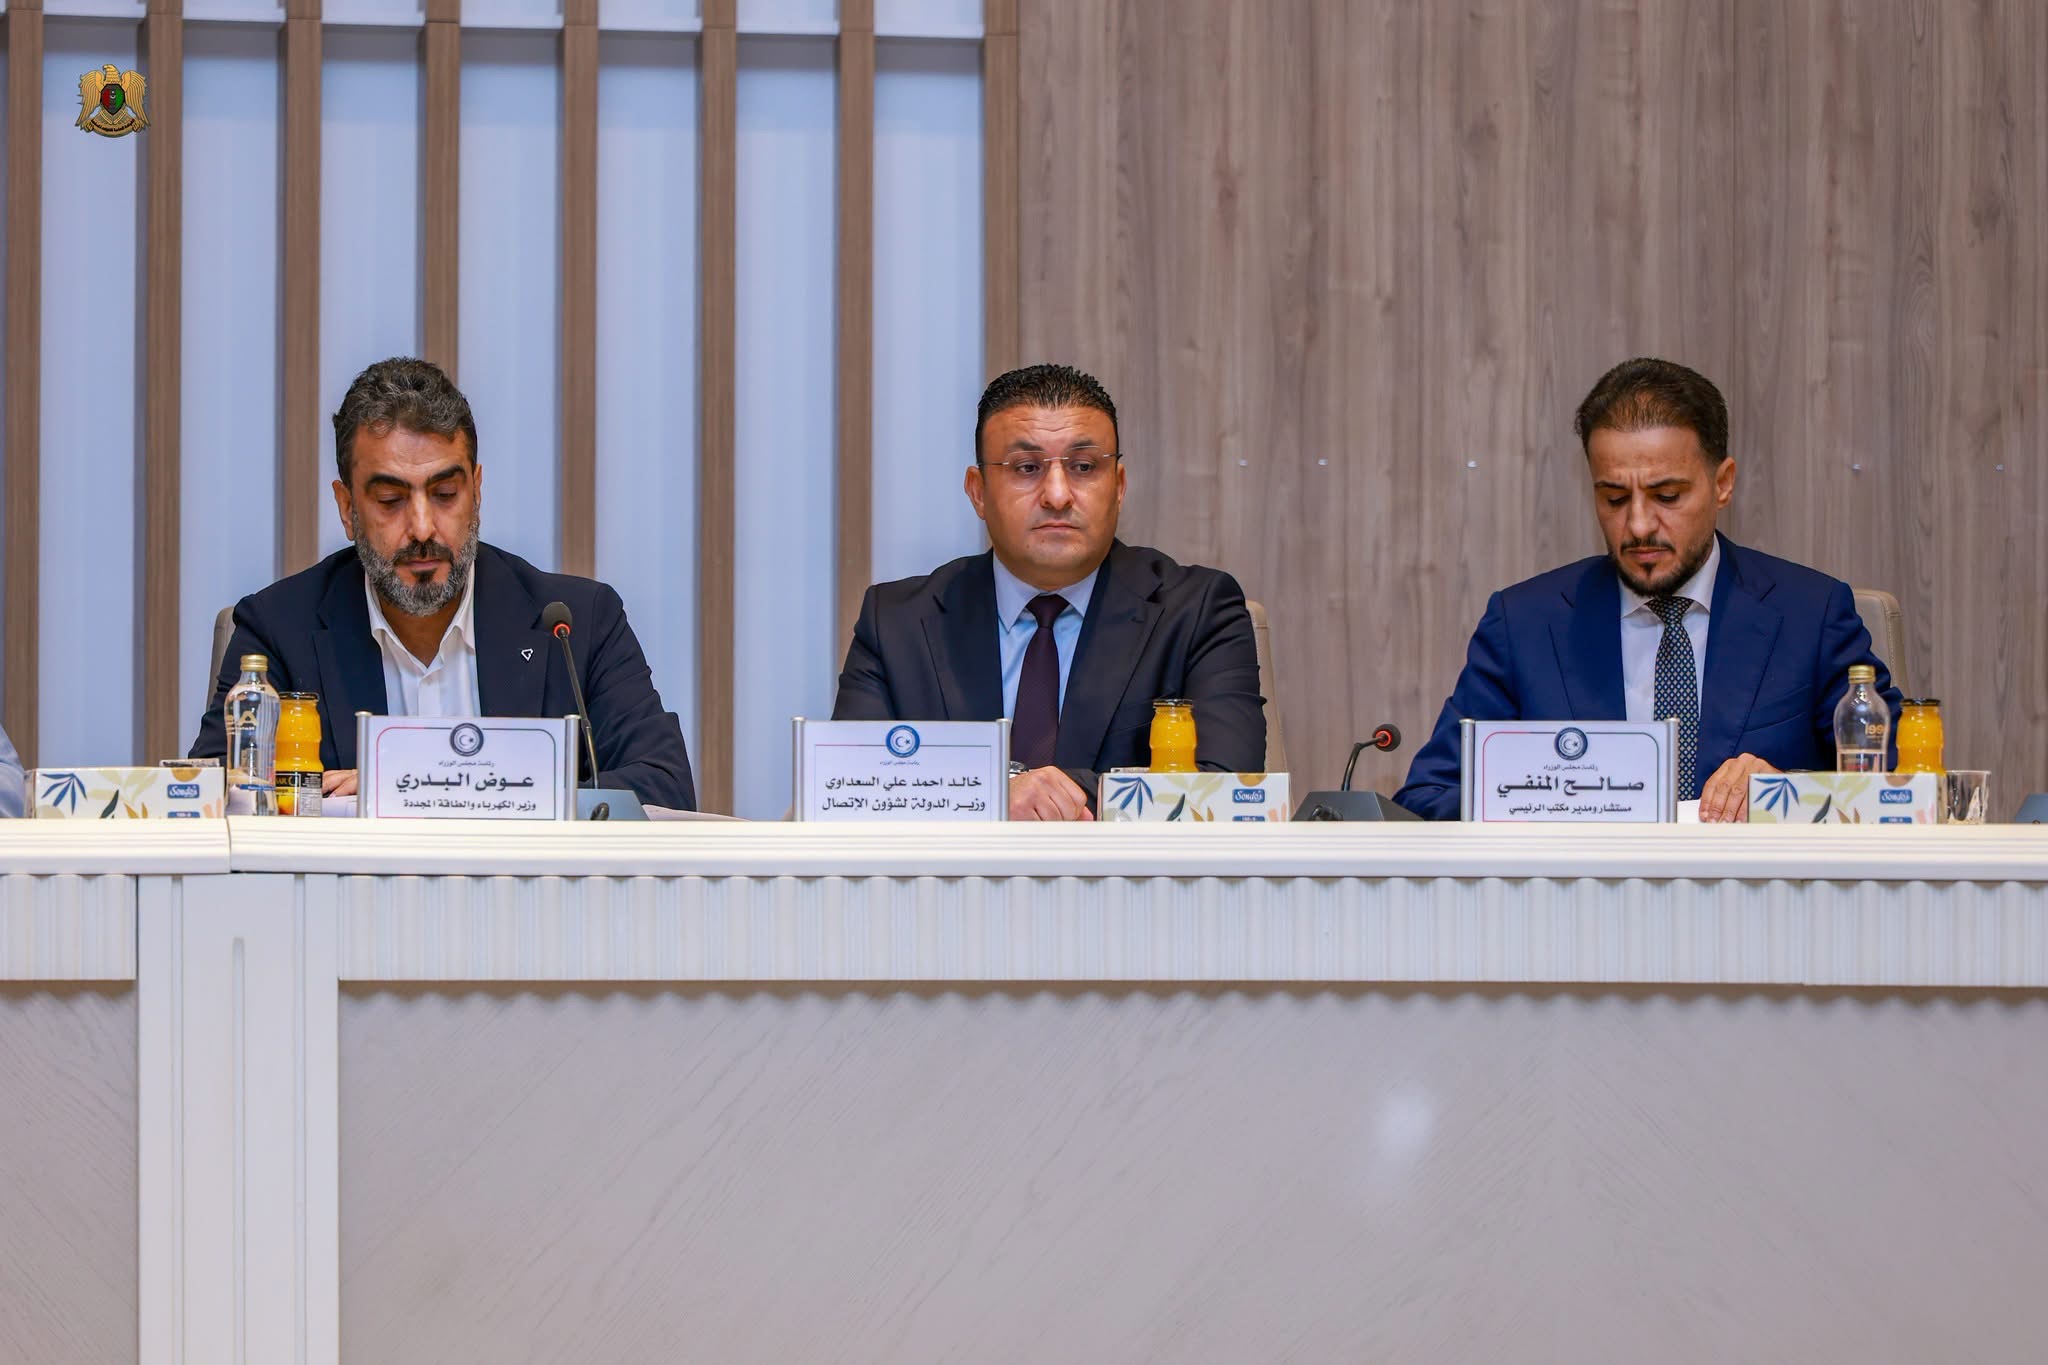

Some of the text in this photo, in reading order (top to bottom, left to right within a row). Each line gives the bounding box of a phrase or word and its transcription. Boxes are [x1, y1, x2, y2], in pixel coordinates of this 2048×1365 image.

[395, 771, 535, 793] عوض البدري
[825, 775, 982, 791] خالد احمد علي السعداوي
[1496, 774, 1645, 798] صالح المنفي
[437, 799, 475, 811] والطاقة
[477, 799, 515, 811] الكهرباء
[517, 800, 536, 812] وزير
[871, 797, 908, 811] لشؤون
[911, 797, 950, 811] الدولة
[953, 797, 986, 811] وزير
[1508, 803, 1632, 815] مستشار ومدير مكتب الرئيسي
